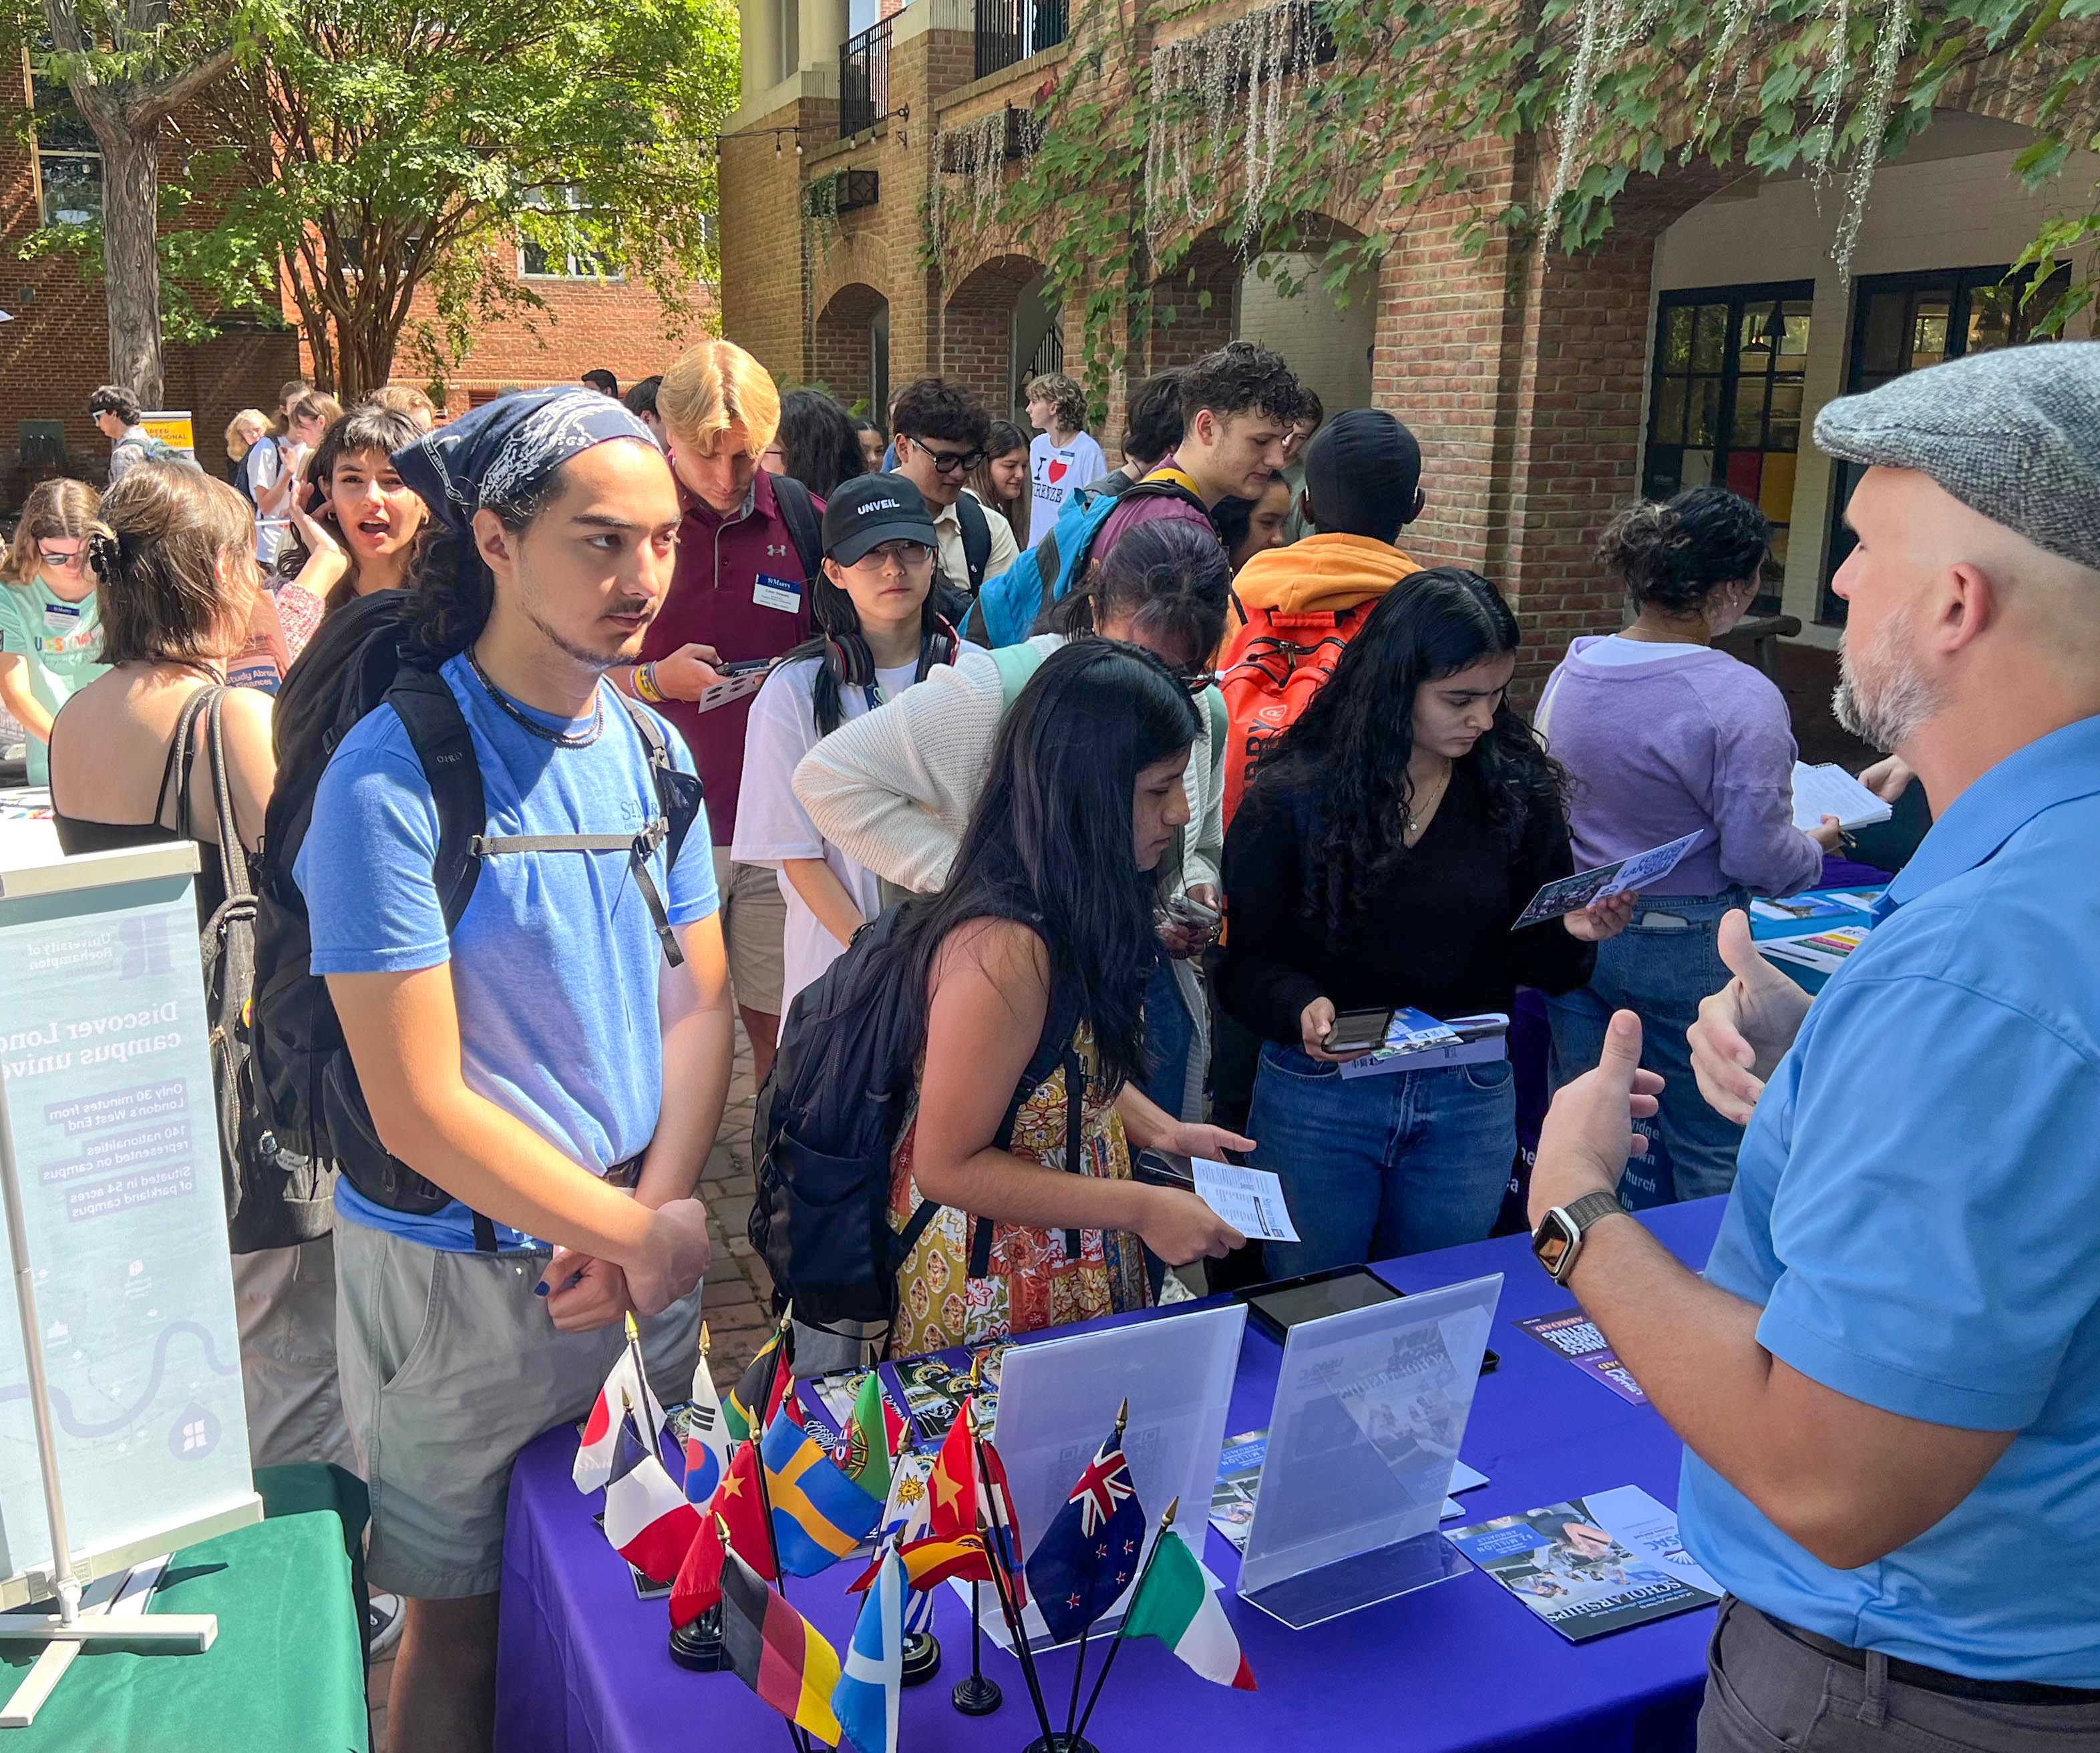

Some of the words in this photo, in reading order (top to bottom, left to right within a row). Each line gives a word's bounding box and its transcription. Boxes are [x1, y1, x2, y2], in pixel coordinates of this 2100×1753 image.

[858, 498, 900, 515] UNVEIL
[1221, 1451, 1260, 1466] MILLION
[1477, 1529, 1518, 1543] ANNUALLY
[1476, 1538, 1519, 1553] MILLION
[1546, 1579, 1683, 1623] SCHOLARSHIPS
